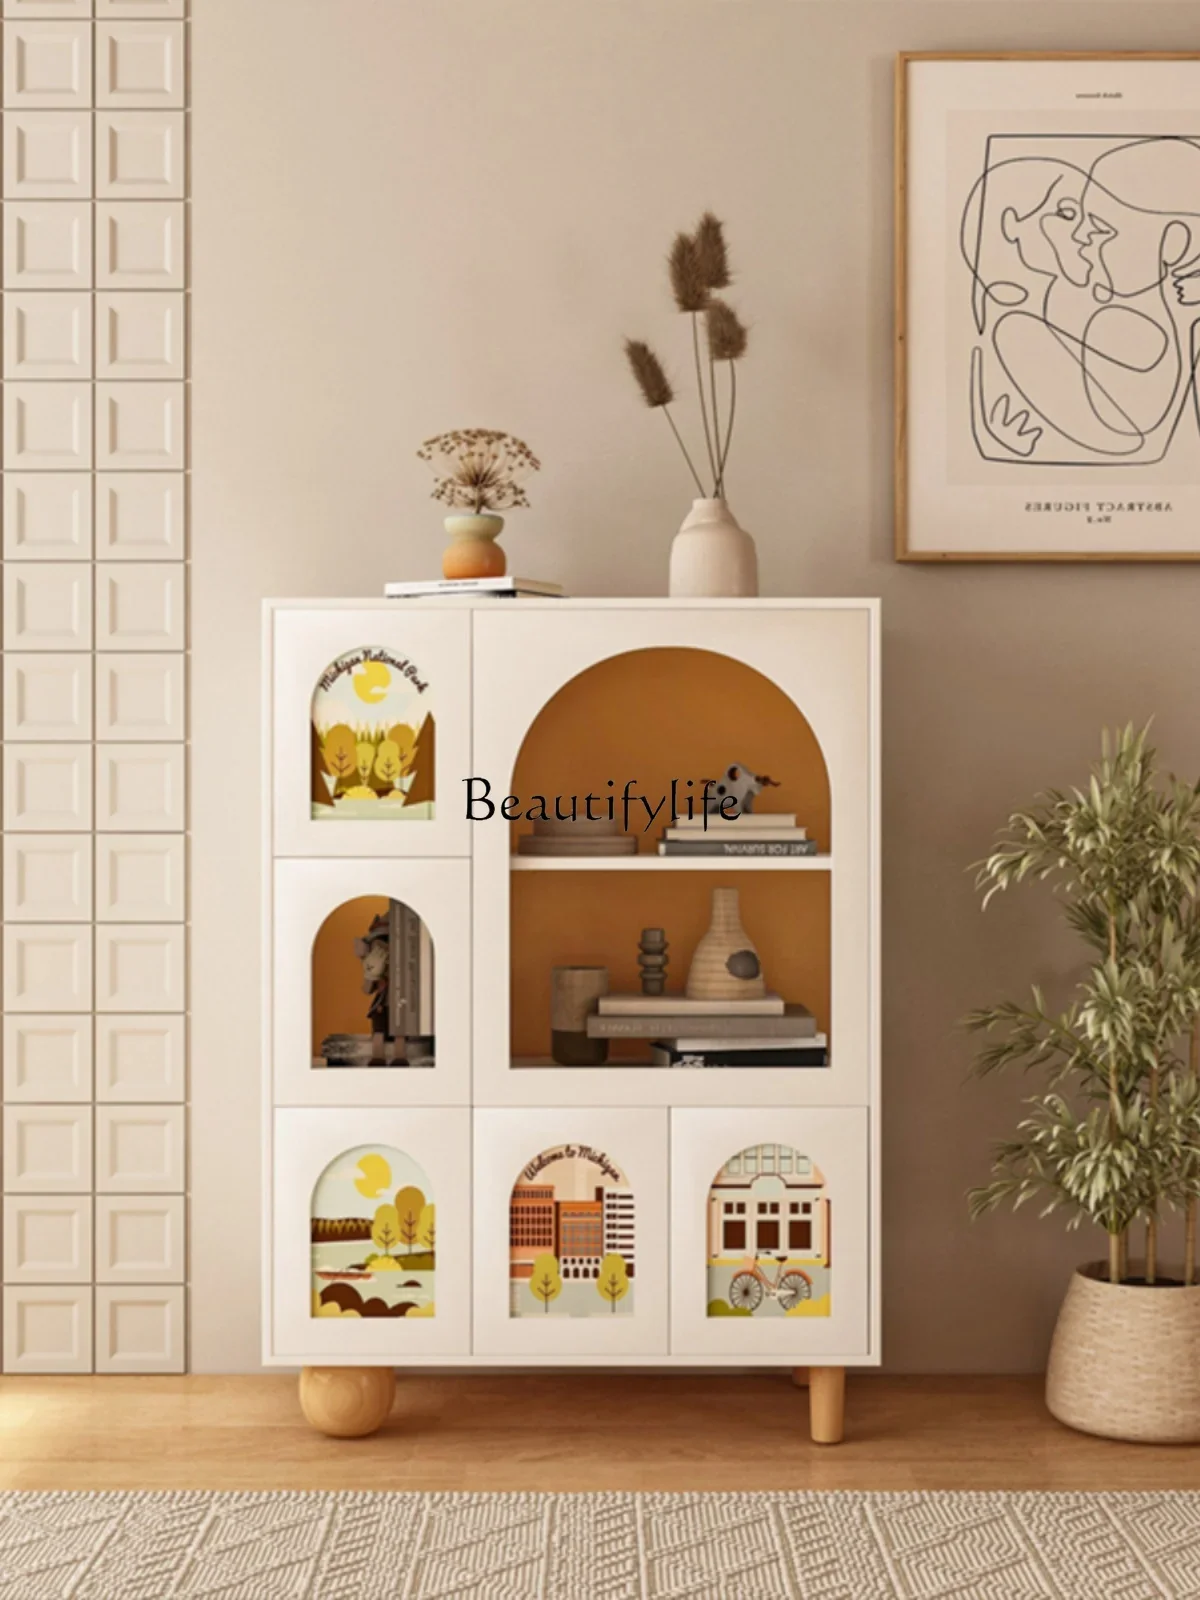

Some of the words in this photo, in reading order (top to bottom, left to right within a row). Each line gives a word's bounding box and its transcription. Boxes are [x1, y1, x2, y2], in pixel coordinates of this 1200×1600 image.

[319, 656, 361, 692] Michigan
[362, 649, 409, 671] National
[404, 665, 429, 694] Park
[768, 843, 788, 854] FOR
[790, 843, 808, 854] ART
[524, 1153, 564, 1181] Welcome
[565, 1144, 577, 1158] to
[577, 1145, 619, 1182] Michigan
